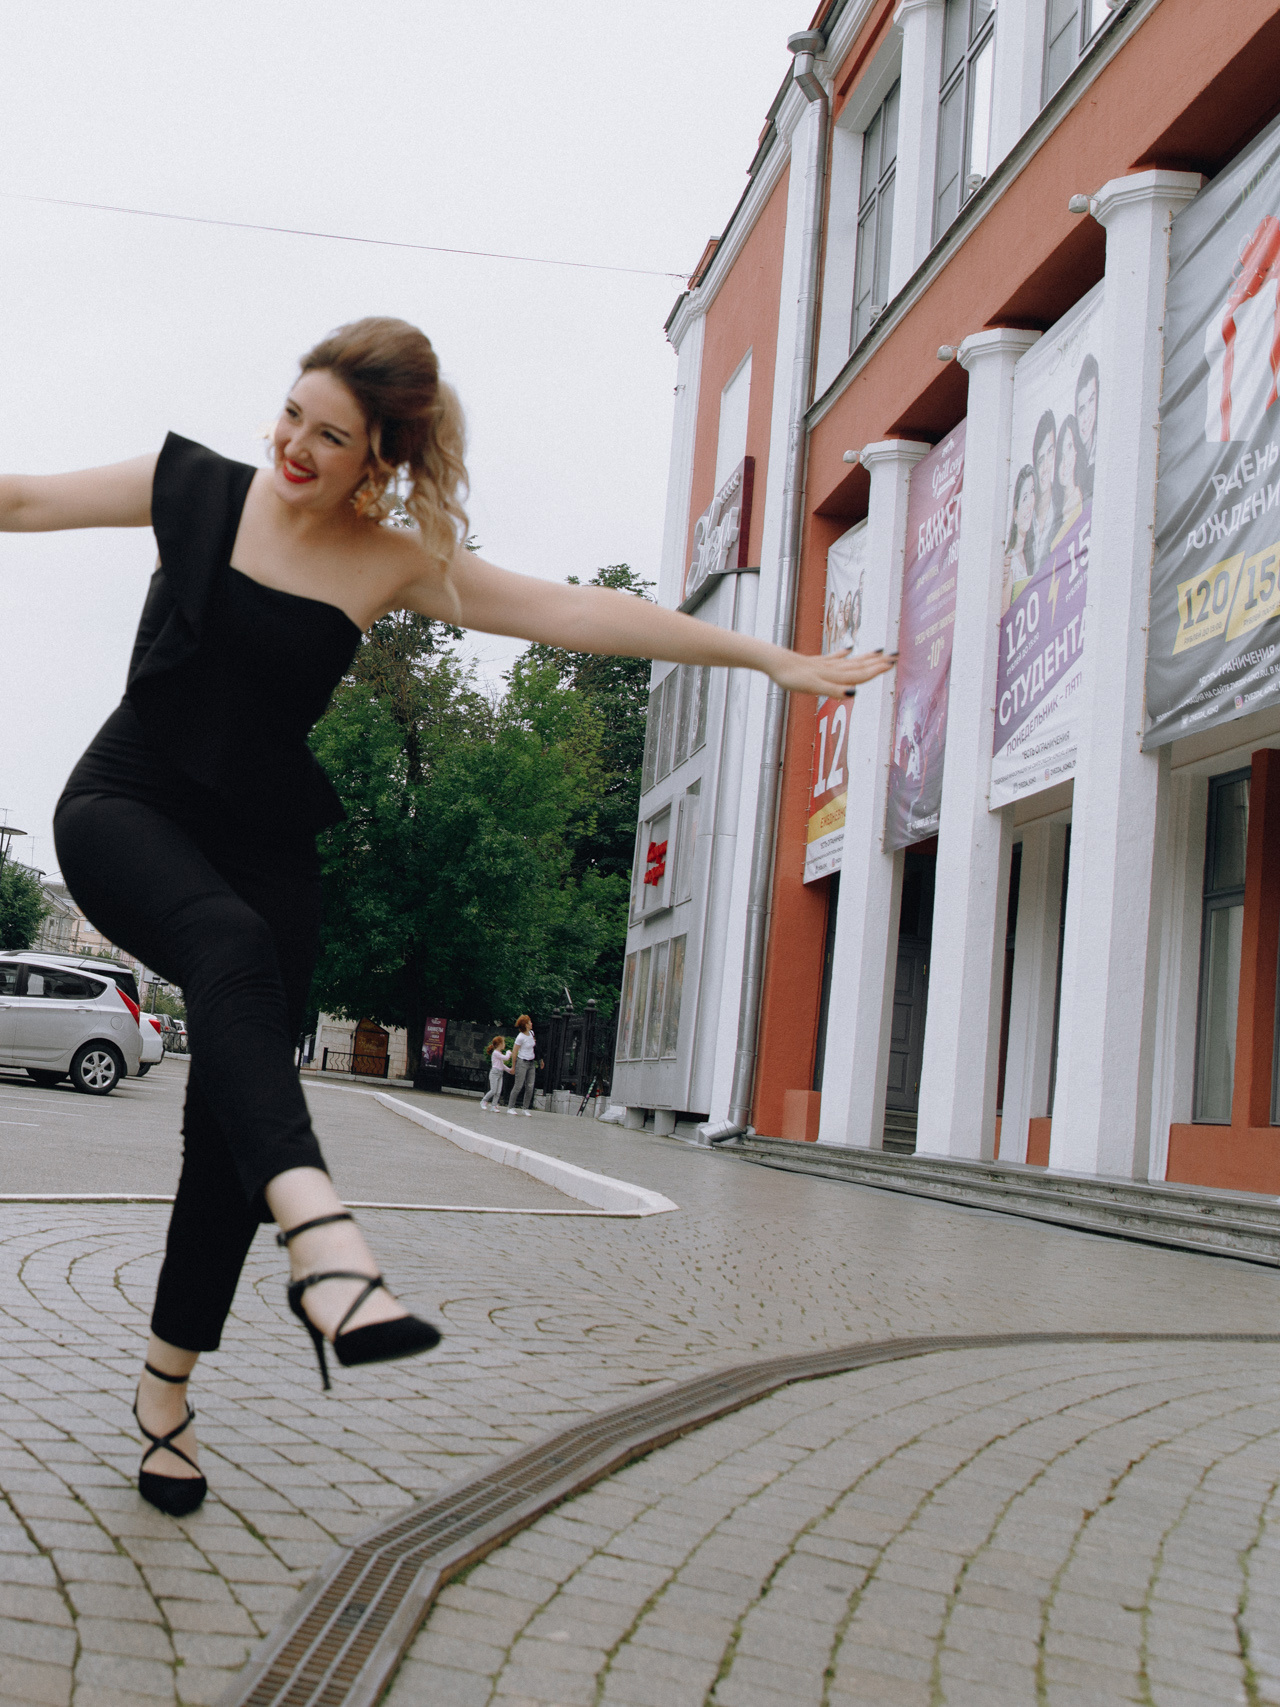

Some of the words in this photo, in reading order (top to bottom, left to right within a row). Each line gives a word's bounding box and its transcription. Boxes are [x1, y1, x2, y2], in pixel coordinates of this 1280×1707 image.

[1183, 570, 1230, 630] 120
[1244, 554, 1280, 611] 15
[1005, 591, 1040, 662] 120
[1006, 694, 1058, 757] ПОНЕДЕЛЬНИК
[1204, 690, 1215, 699] НА
